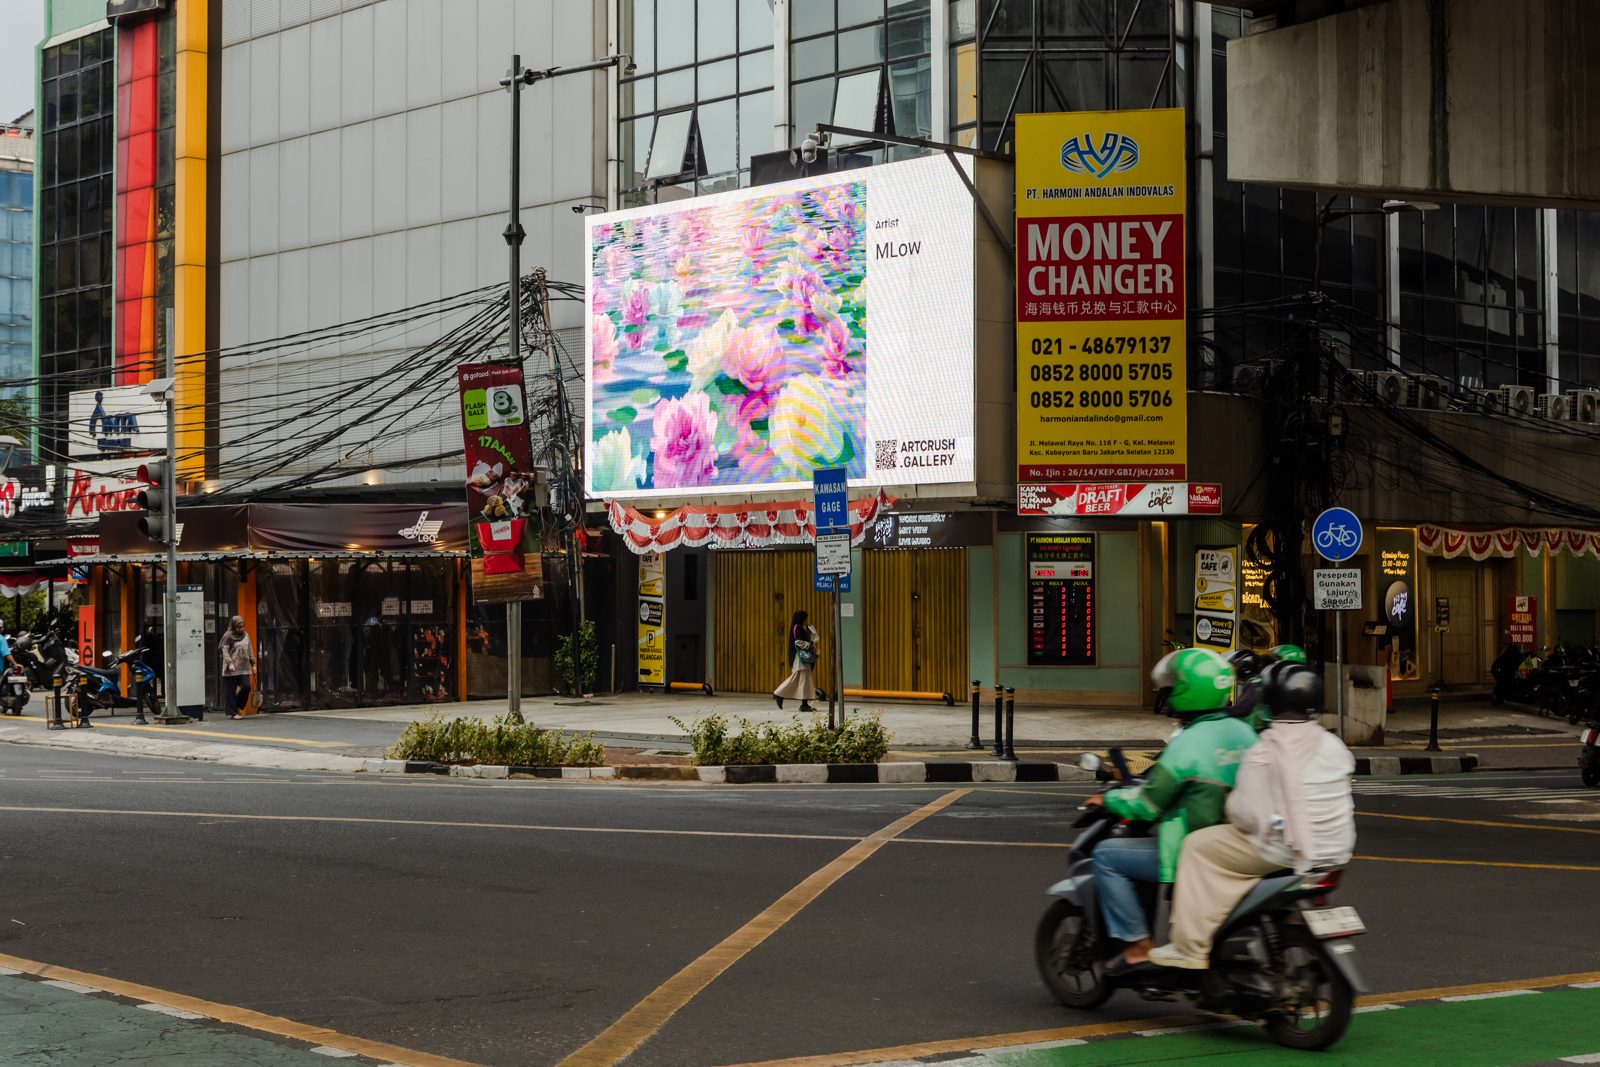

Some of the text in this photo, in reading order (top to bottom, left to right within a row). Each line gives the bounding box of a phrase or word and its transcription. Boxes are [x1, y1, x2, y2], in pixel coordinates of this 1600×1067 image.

[1026, 185, 1174, 199] PT. HARMONI ANDALAN INDOVALAS
[875, 218, 899, 229] Artist
[1027, 221, 1173, 261] MONEY
[1028, 264, 1174, 296] CHANGER
[1031, 338, 1062, 355] 021
[1081, 336, 1171, 354] 48679137
[470, 371, 489, 380] gofood
[1030, 363, 1173, 382] 0852 8000 5705
[1030, 390, 1173, 408] 0852 8000 5706
[465, 402, 486, 410] FLASH
[1040, 414, 1163, 423] harmoniandalindo@gmail.com
[901, 439, 955, 453] ARTCRUSH
[1067, 440, 1084, 448] Raya
[1045, 449, 1081, 457] Kebayoran
[900, 454, 955, 468] .GALLERY
[1045, 469, 1061, 478] Ijin
[1068, 468, 1175, 478] 26/14/KEP.GBI/jkt/2024
[815, 482, 846, 494] KAWASAN
[1162, 485, 1175, 495] my
[1079, 489, 1122, 506] DRAFT
[821, 502, 841, 513] GAGE
[1085, 502, 1110, 513] BEER
[1201, 562, 1217, 571] CAFE
[1316, 572, 1358, 580] Pesepeda
[1319, 580, 1356, 588] Gunakan
[1326, 588, 1348, 598] Lajur
[1322, 597, 1354, 606] Sepeda
